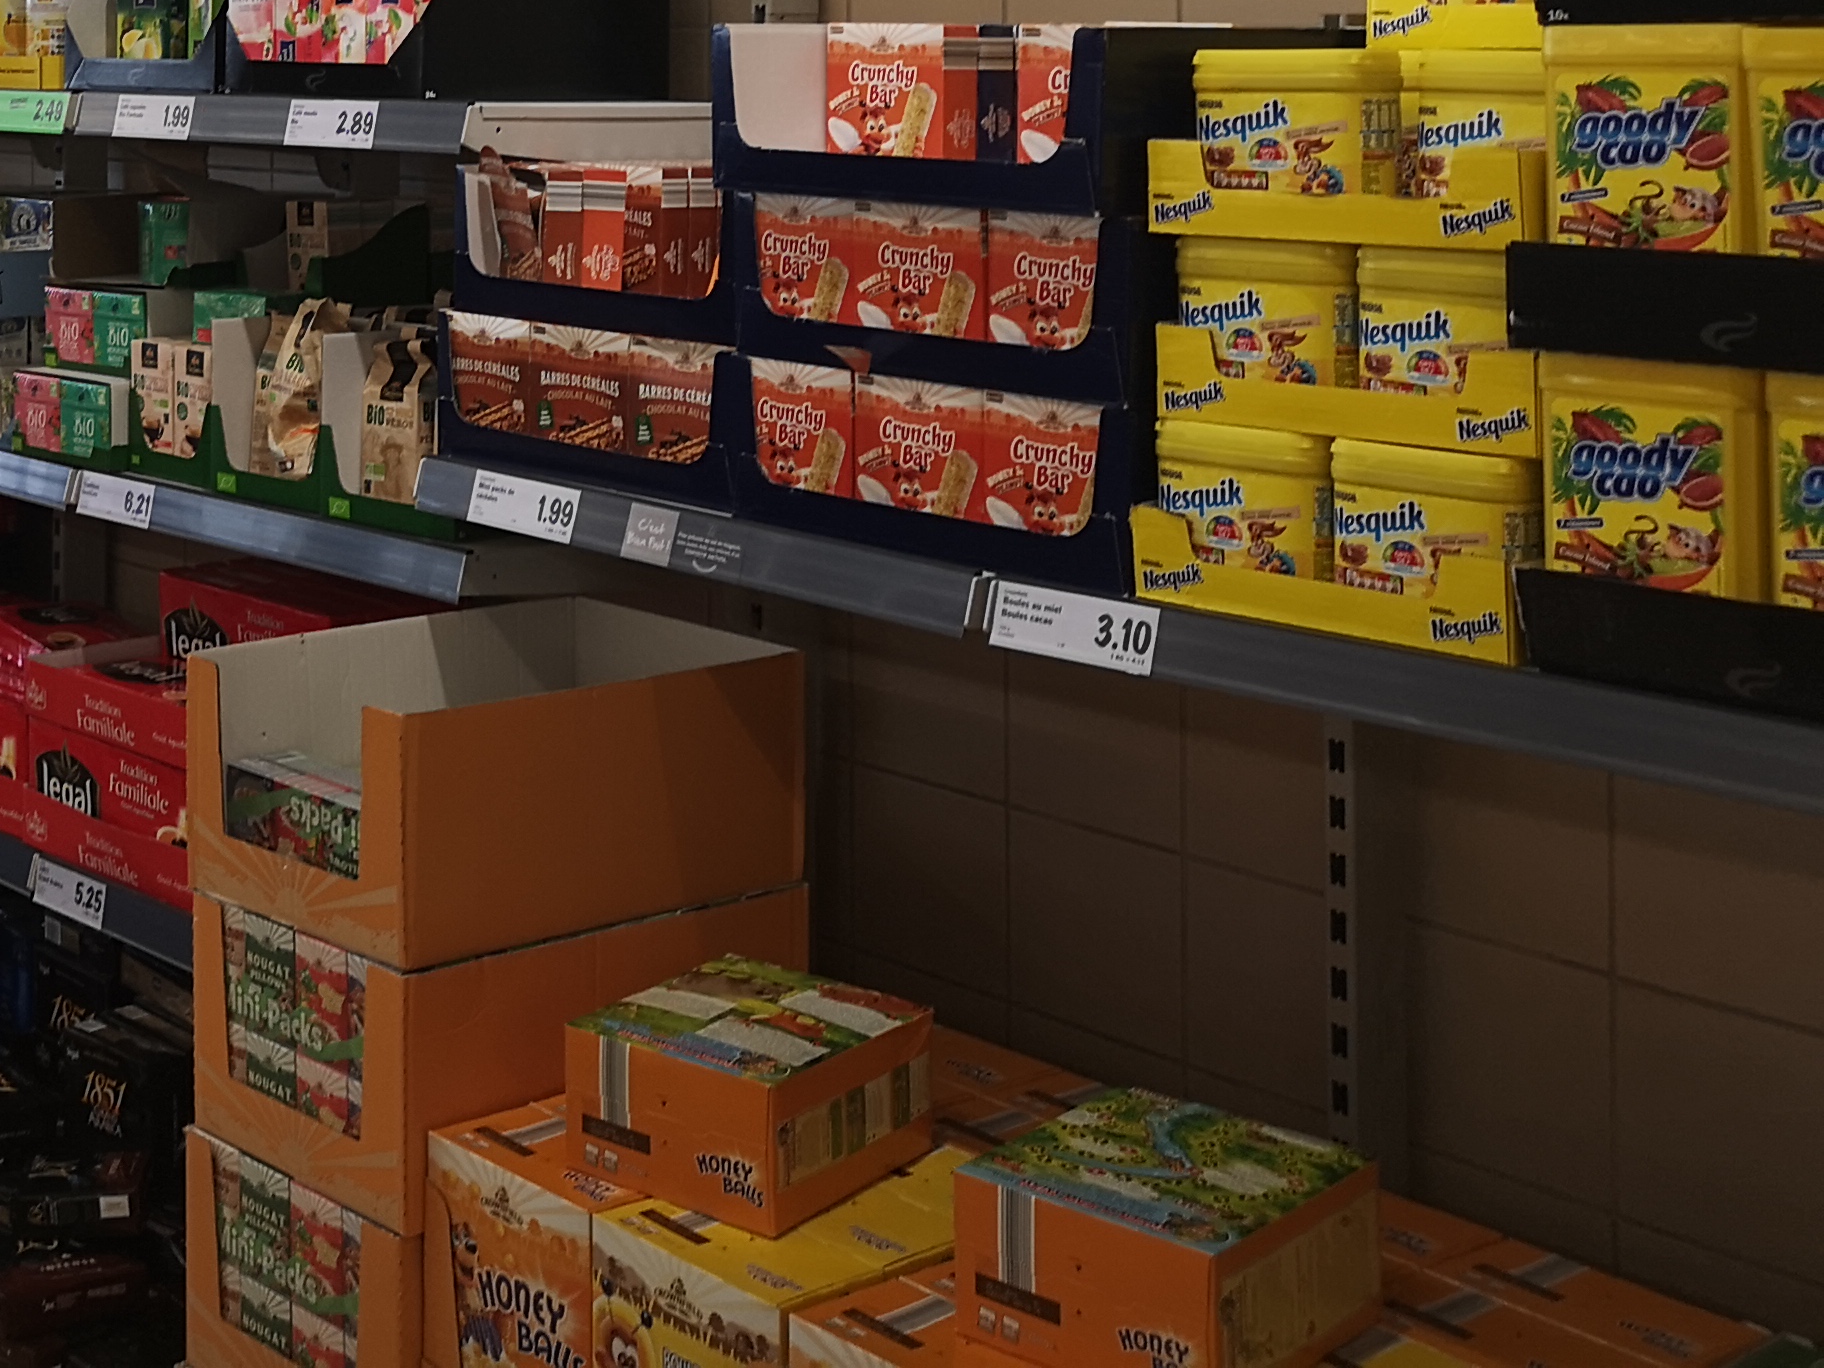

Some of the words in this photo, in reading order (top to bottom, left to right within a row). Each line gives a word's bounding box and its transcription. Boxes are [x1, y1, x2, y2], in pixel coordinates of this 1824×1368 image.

[1372, 5, 1433, 39] Nesquik
[848, 58, 917, 92] Crunchy
[33, 99, 64, 122] 2.49
[866, 83, 899, 108] Bar
[162, 104, 190, 127] 1.99
[335, 111, 374, 135] 2.89
[1198, 98, 1289, 144] Nesquik
[1571, 97, 1706, 152] goody
[1597, 139, 1669, 170] cao
[1153, 189, 1215, 224] Nesquik
[1441, 198, 1516, 238] Nesquik
[761, 229, 829, 262] Crunchy
[877, 240, 954, 278] Crunchy
[779, 254, 811, 281] Bar
[897, 268, 933, 295] Bar
[1013, 252, 1096, 289] Crunchy
[1034, 280, 1074, 308] Bar
[483, 359, 520, 382] CÉRÉALES
[540, 370, 568, 387] BARRES
[569, 374, 581, 387] DE
[581, 371, 620, 398] CÉRÉALES
[547, 389, 582, 402] CHOCOLAT
[584, 393, 596, 403] AU
[597, 394, 612, 409] LAIT
[638, 383, 668, 400] BARRES
[670, 387, 683, 400] DE
[1163, 380, 1227, 413] Nesquik
[366, 403, 385, 426] BIO
[757, 395, 826, 431] Crunchy
[1456, 407, 1531, 444] Nesquik
[775, 421, 807, 449] Bar
[879, 415, 956, 454] Crunchy
[899, 444, 934, 471] Bar
[1010, 435, 1096, 478] Crunchy
[1567, 433, 1699, 486] goody
[1033, 464, 1073, 493] Bar
[1592, 471, 1665, 503] cao
[536, 494, 574, 528] 1.99
[1158, 478, 1244, 514] Nesquik
[1142, 562, 1204, 593] Nesquik
[1000, 608, 1028, 622] Boules
[1029, 614, 1053, 626] cacao
[1002, 595, 1029, 609] Boules
[1031, 602, 1042, 611] au
[1043, 603, 1063, 615] miel
[1094, 613, 1153, 656] 3.10
[1430, 610, 1503, 644] Nesquik
[84, 693, 122, 717] Tradition
[77, 708, 136, 747] Familiale
[119, 759, 158, 785] Tradition
[109, 773, 169, 814] Familiale
[85, 831, 123, 858] Tradition
[78, 844, 138, 886] Familiale
[75, 882, 103, 913] 5.25
[247, 949, 292, 981] NOUGAT
[80, 1069, 129, 1110] 1851
[247, 1067, 293, 1100] NOUGAT
[696, 1152, 755, 1181] HONEY
[722, 1175, 765, 1209] BALLS
[241, 1195, 287, 1225] NOUGAT
[476, 1268, 567, 1334] HONEY
[242, 1314, 288, 1348] NOUGAT
[1117, 1327, 1190, 1364] HONEY
